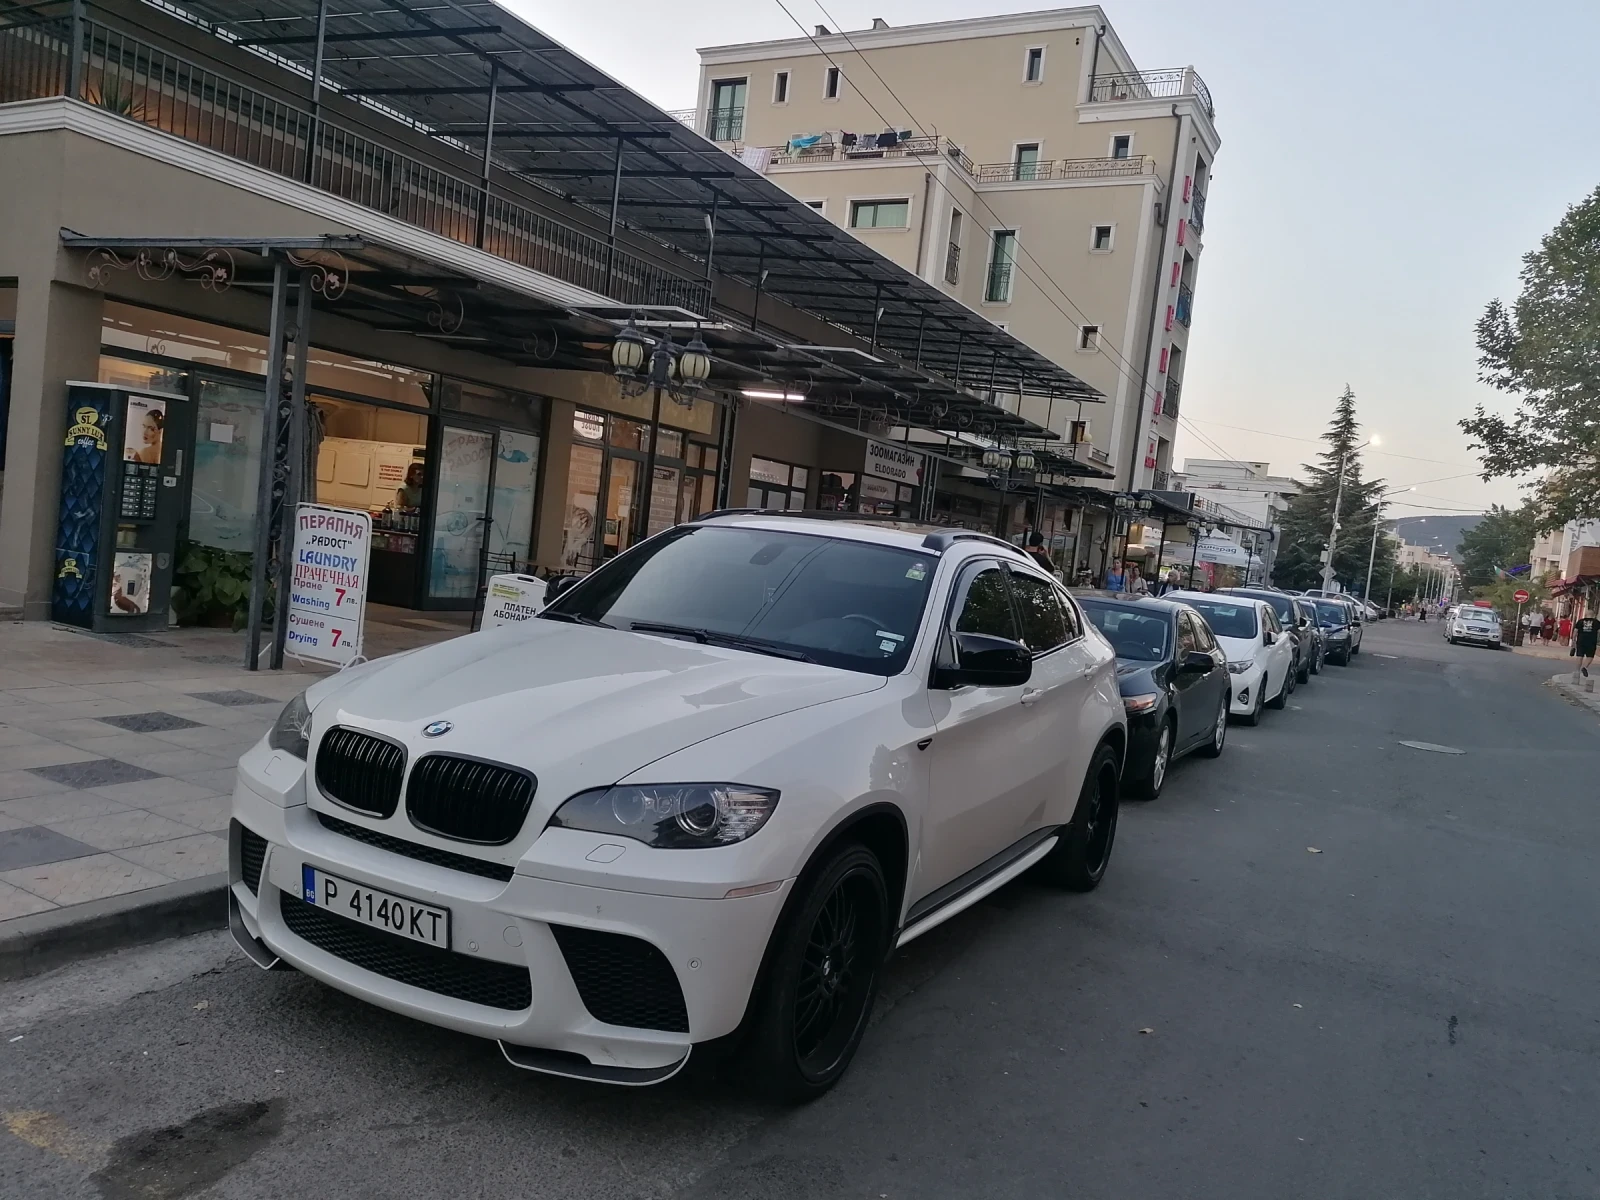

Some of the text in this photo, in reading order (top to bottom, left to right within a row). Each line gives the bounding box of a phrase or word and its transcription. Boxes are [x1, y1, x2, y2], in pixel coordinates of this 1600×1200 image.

[81, 415, 92, 425] SL
[69, 427, 91, 437] SUNNY
[77, 436, 95, 448] coffee
[869, 443, 915, 467] ЗООМАГАЗИН
[874, 463, 907, 479] ELDORADO
[299, 514, 364, 540] ПЕРАЛНЯ
[299, 549, 358, 573] LAUNDRY
[293, 577, 323, 591] Пране
[295, 563, 360, 589] ПРАЧЕЧНАЯ
[292, 593, 330, 610] Washing
[335, 587, 346, 607] 7
[503, 602, 537, 616] ПЛАТЕН
[289, 613, 325, 628] Сушене
[288, 630, 318, 647] Drying
[331, 628, 342, 647] 7
[305, 889, 315, 899] BG
[324, 878, 338, 906] P
